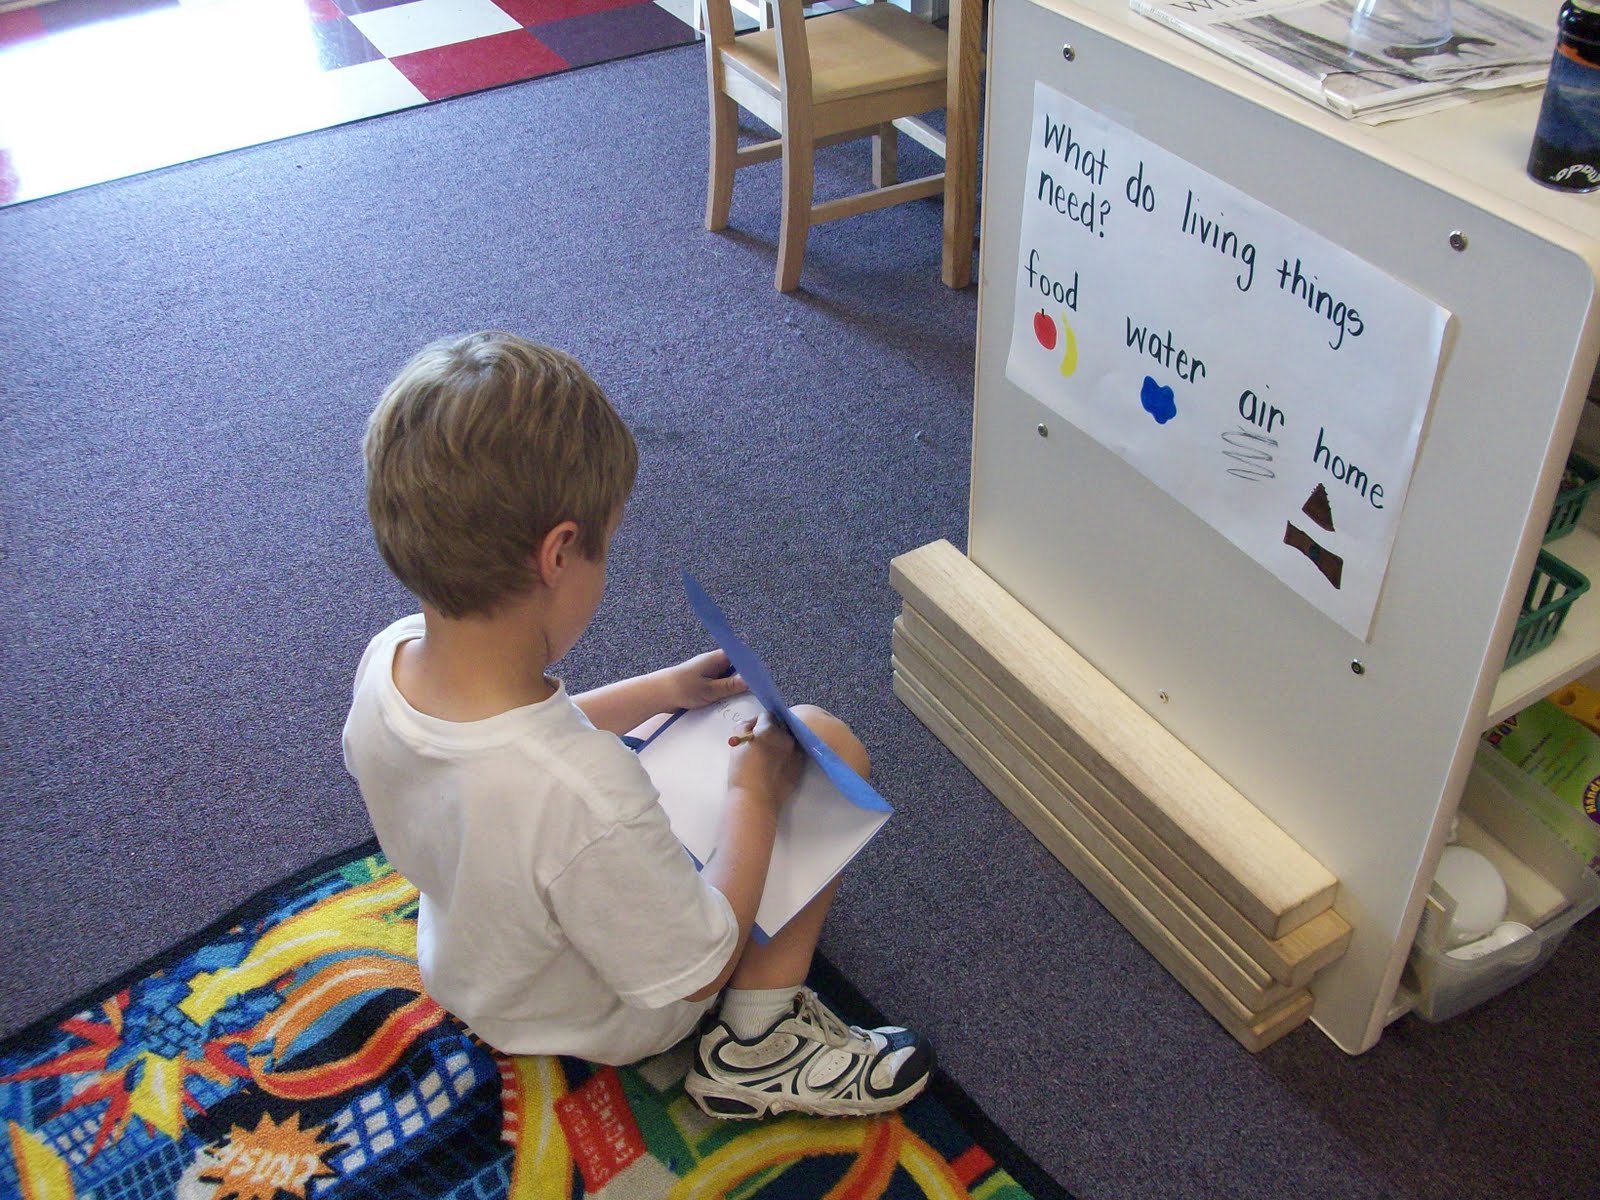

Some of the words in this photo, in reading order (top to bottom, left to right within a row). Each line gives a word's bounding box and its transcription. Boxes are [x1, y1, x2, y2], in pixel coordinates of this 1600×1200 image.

[1037, 169, 1112, 239] need?
[1043, 112, 1110, 186] What
[1125, 160, 1156, 213] do
[1181, 188, 1257, 293] living
[1275, 257, 1365, 351] things
[1023, 248, 1079, 313] food
[1126, 315, 1207, 385] water
[1238, 384, 1285, 434] air
[1312, 426, 1384, 510] home
